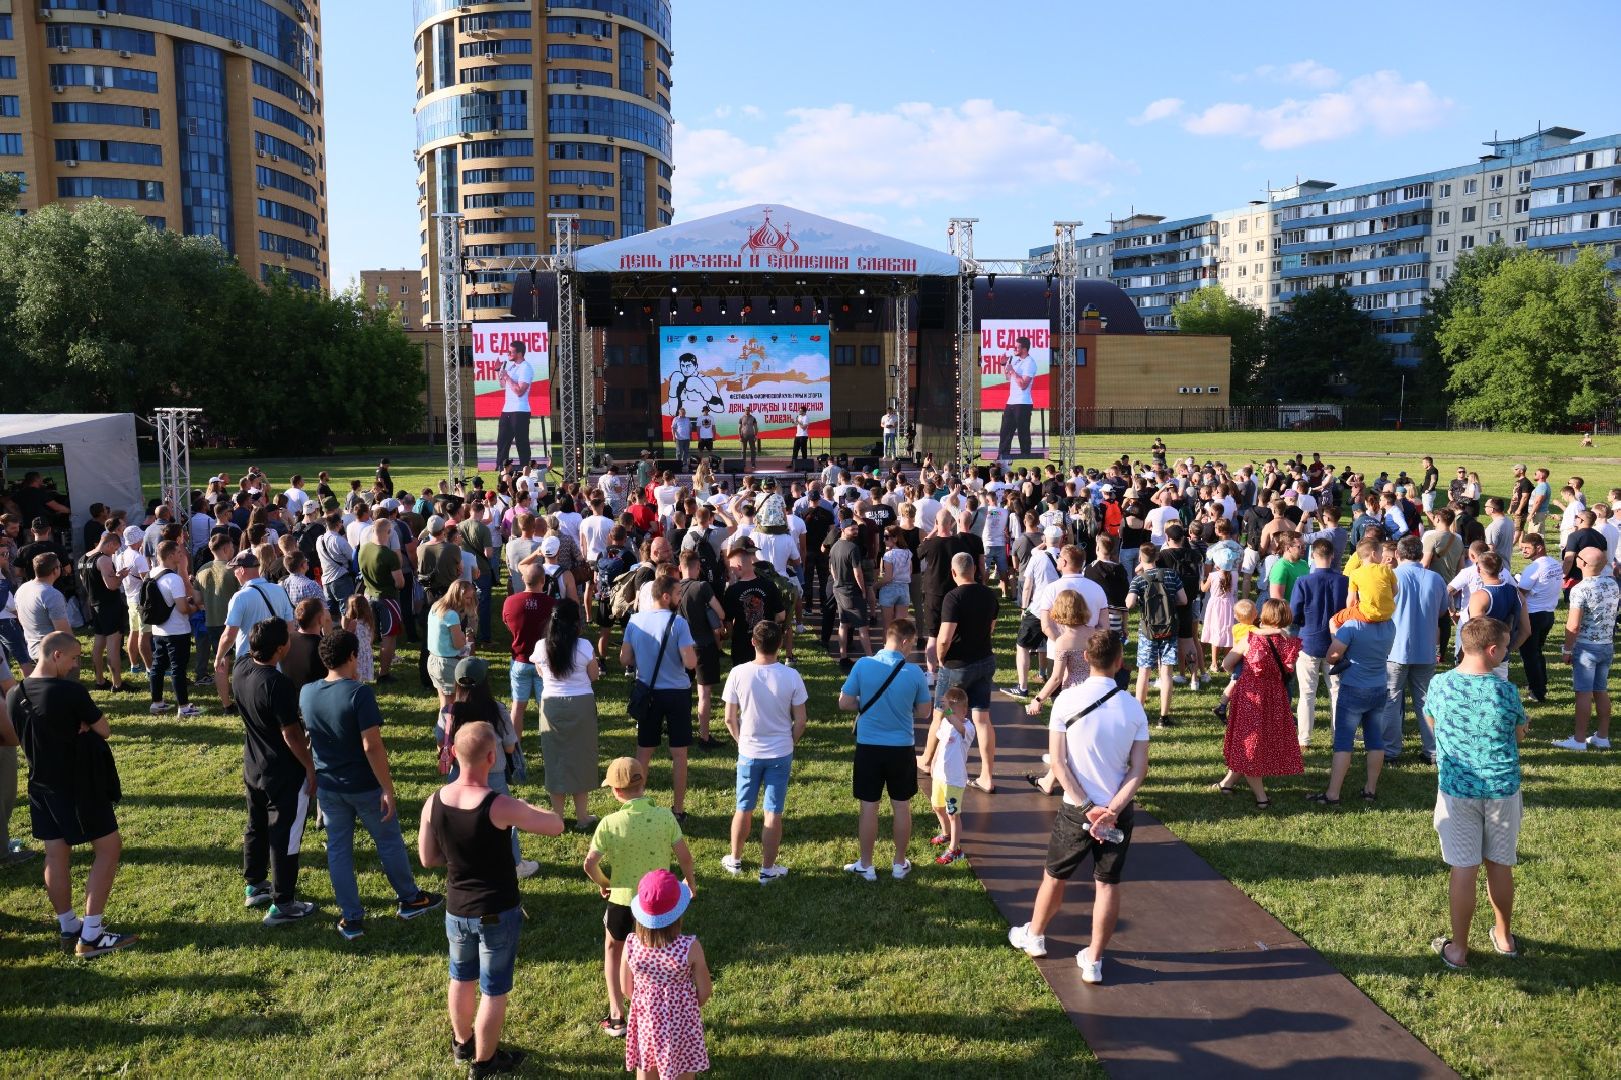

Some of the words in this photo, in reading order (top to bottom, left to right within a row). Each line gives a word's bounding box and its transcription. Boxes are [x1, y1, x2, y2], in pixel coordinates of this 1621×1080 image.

[620, 255, 662, 270] ДЕНЬ
[669, 254, 742, 270] ДРУЖБЫ
[750, 254, 760, 268] И
[767, 254, 849, 270] ЕДИНЕНИЯ
[857, 256, 917, 272] СЛАВЯН
[982, 329, 991, 348] И
[97, 935, 118, 947] N
